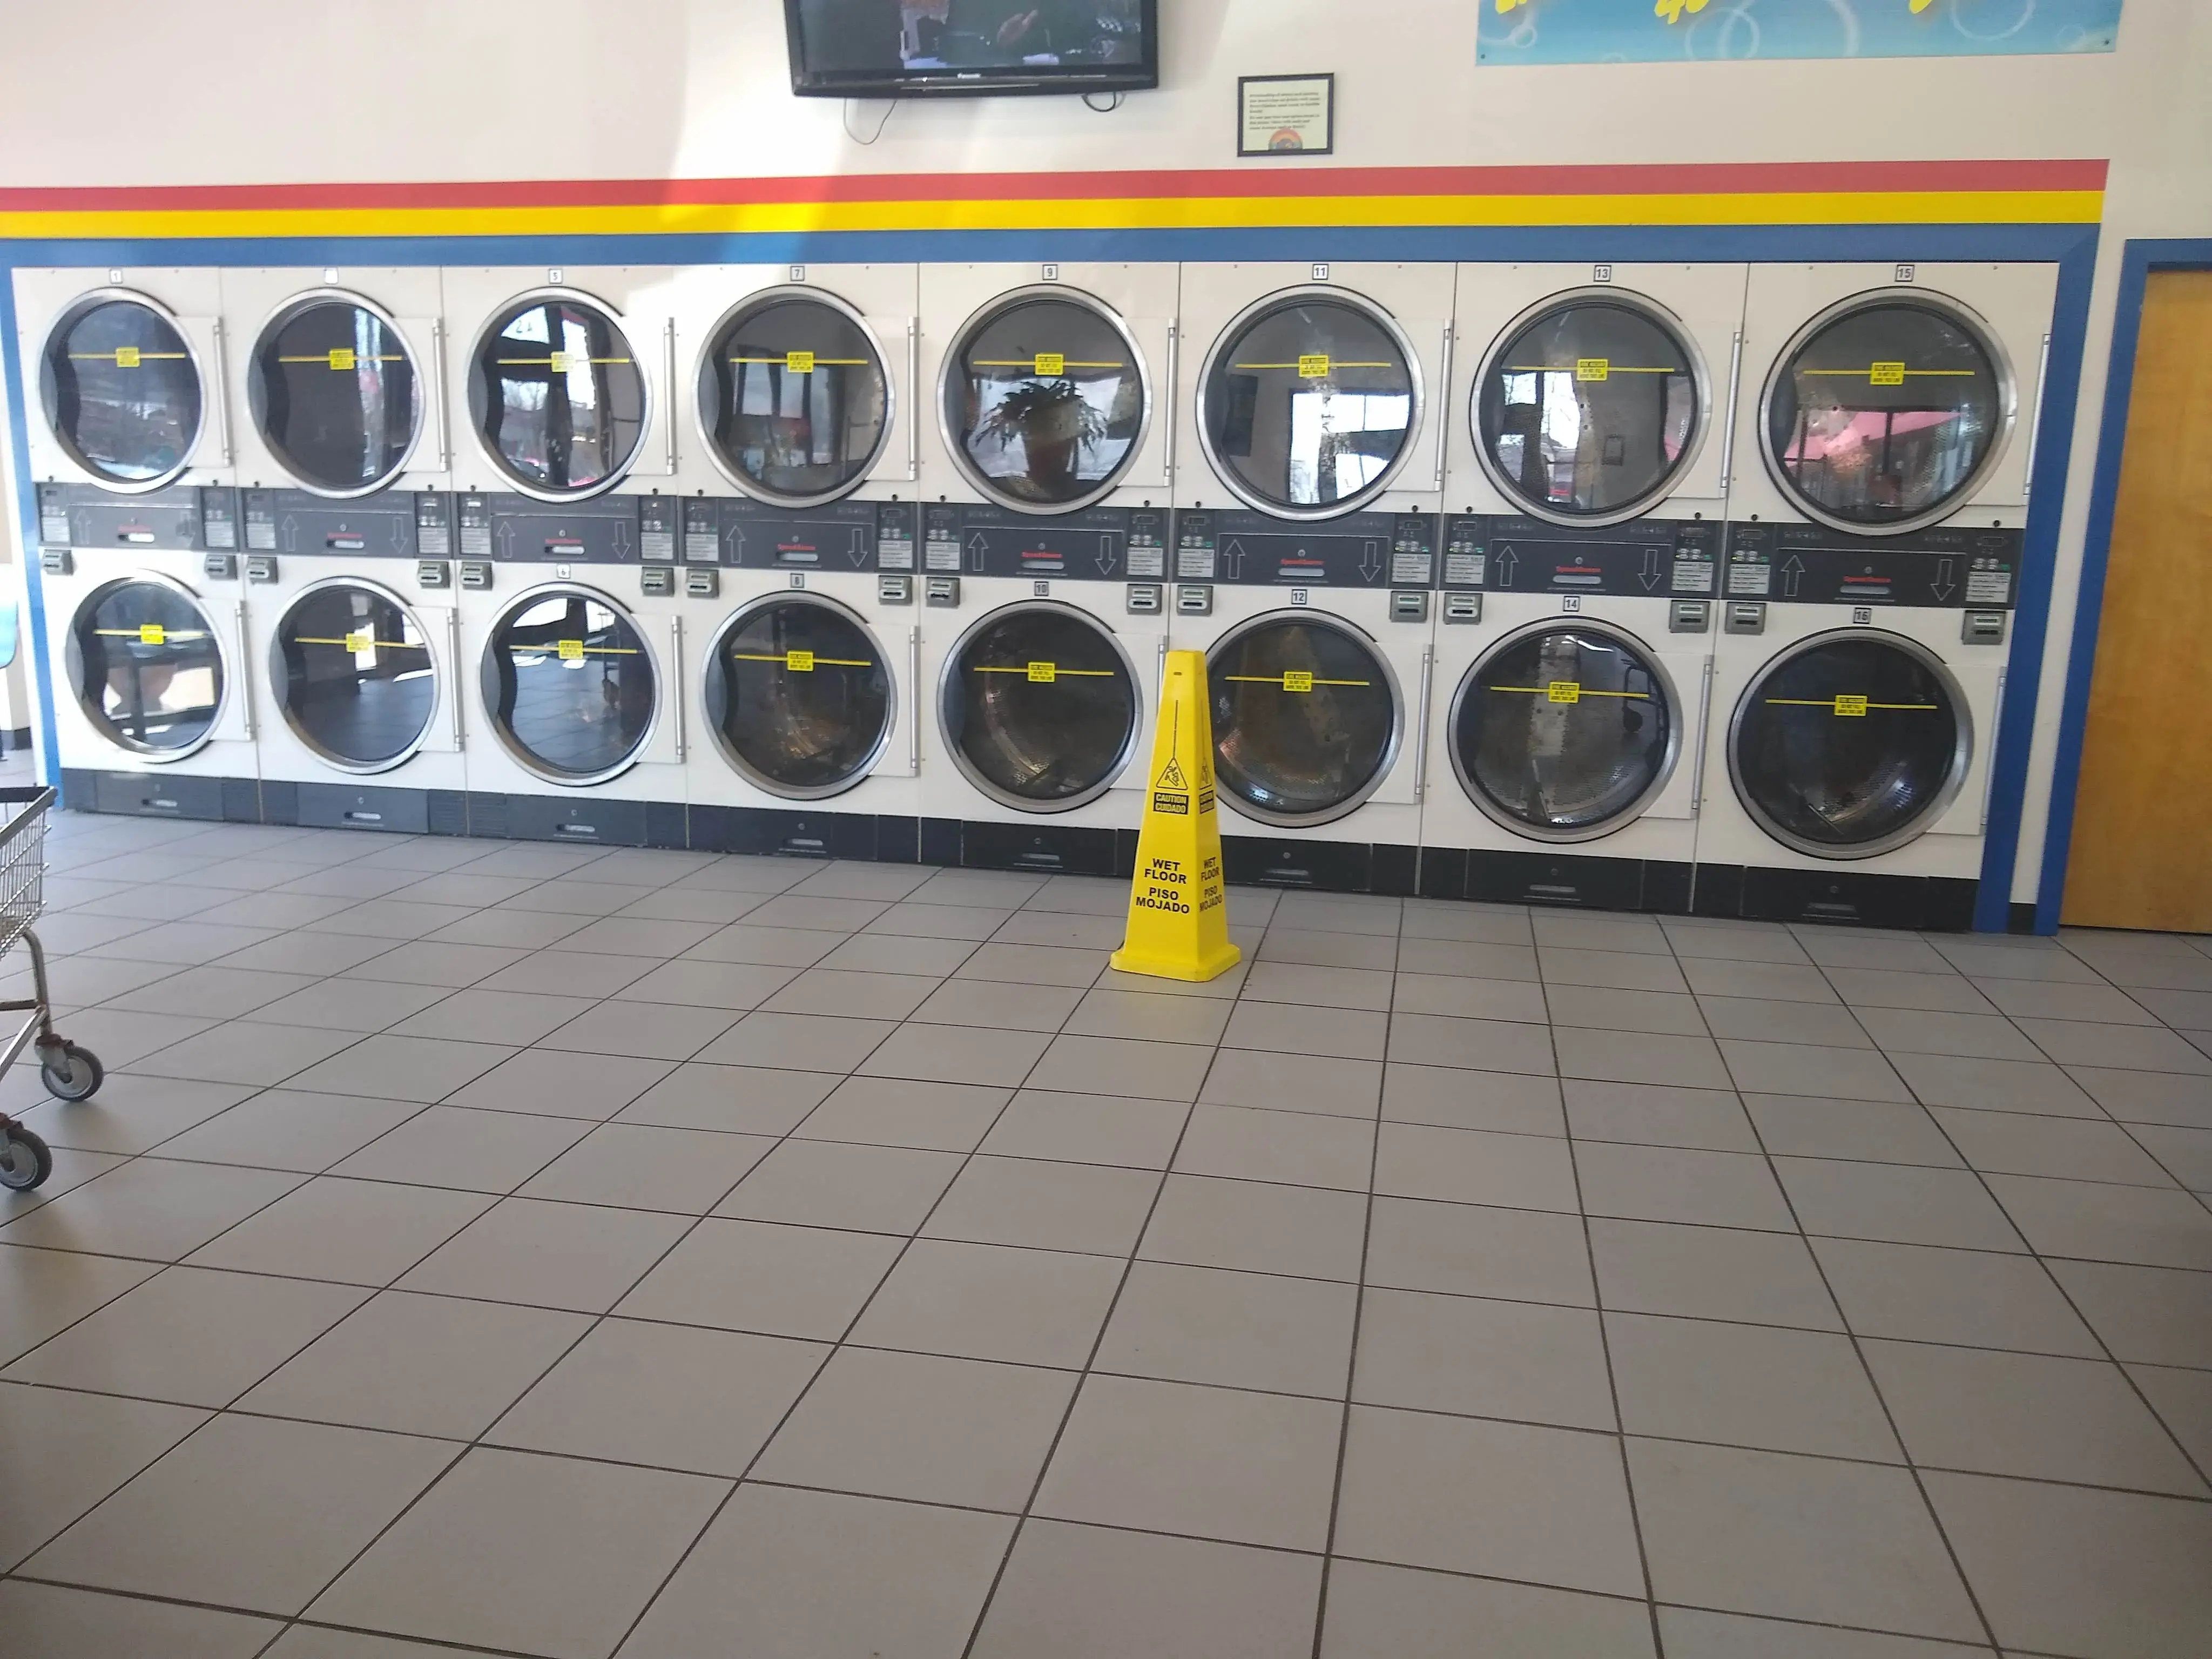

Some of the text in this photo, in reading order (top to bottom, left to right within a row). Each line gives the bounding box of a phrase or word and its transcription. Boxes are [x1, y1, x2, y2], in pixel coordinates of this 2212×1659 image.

[552, 272, 558, 281] 5
[794, 269, 800, 278] 7
[1047, 268, 1053, 277] 9
[1315, 268, 1326, 276] 11
[1597, 269, 1608, 278] 13
[1898, 268, 1911, 278] 15
[1036, 584, 1047, 593] 10
[1293, 592, 1304, 601] 12
[1566, 599, 1577, 608] 14
[1856, 611, 1868, 620] 16
[1156, 793, 1187, 804] CAUTION
[1156, 802, 1186, 813] CUIDADO
[1152, 858, 1181, 871] WET
[1204, 857, 1216, 868] WET
[1144, 868, 1187, 884] FLOOR
[1201, 867, 1220, 881] FLOOR
[1149, 887, 1179, 900] PISO
[1204, 885, 1218, 898] PISO
[1136, 896, 1190, 914] MOJADO
[1199, 894, 1223, 912] MOJADO
